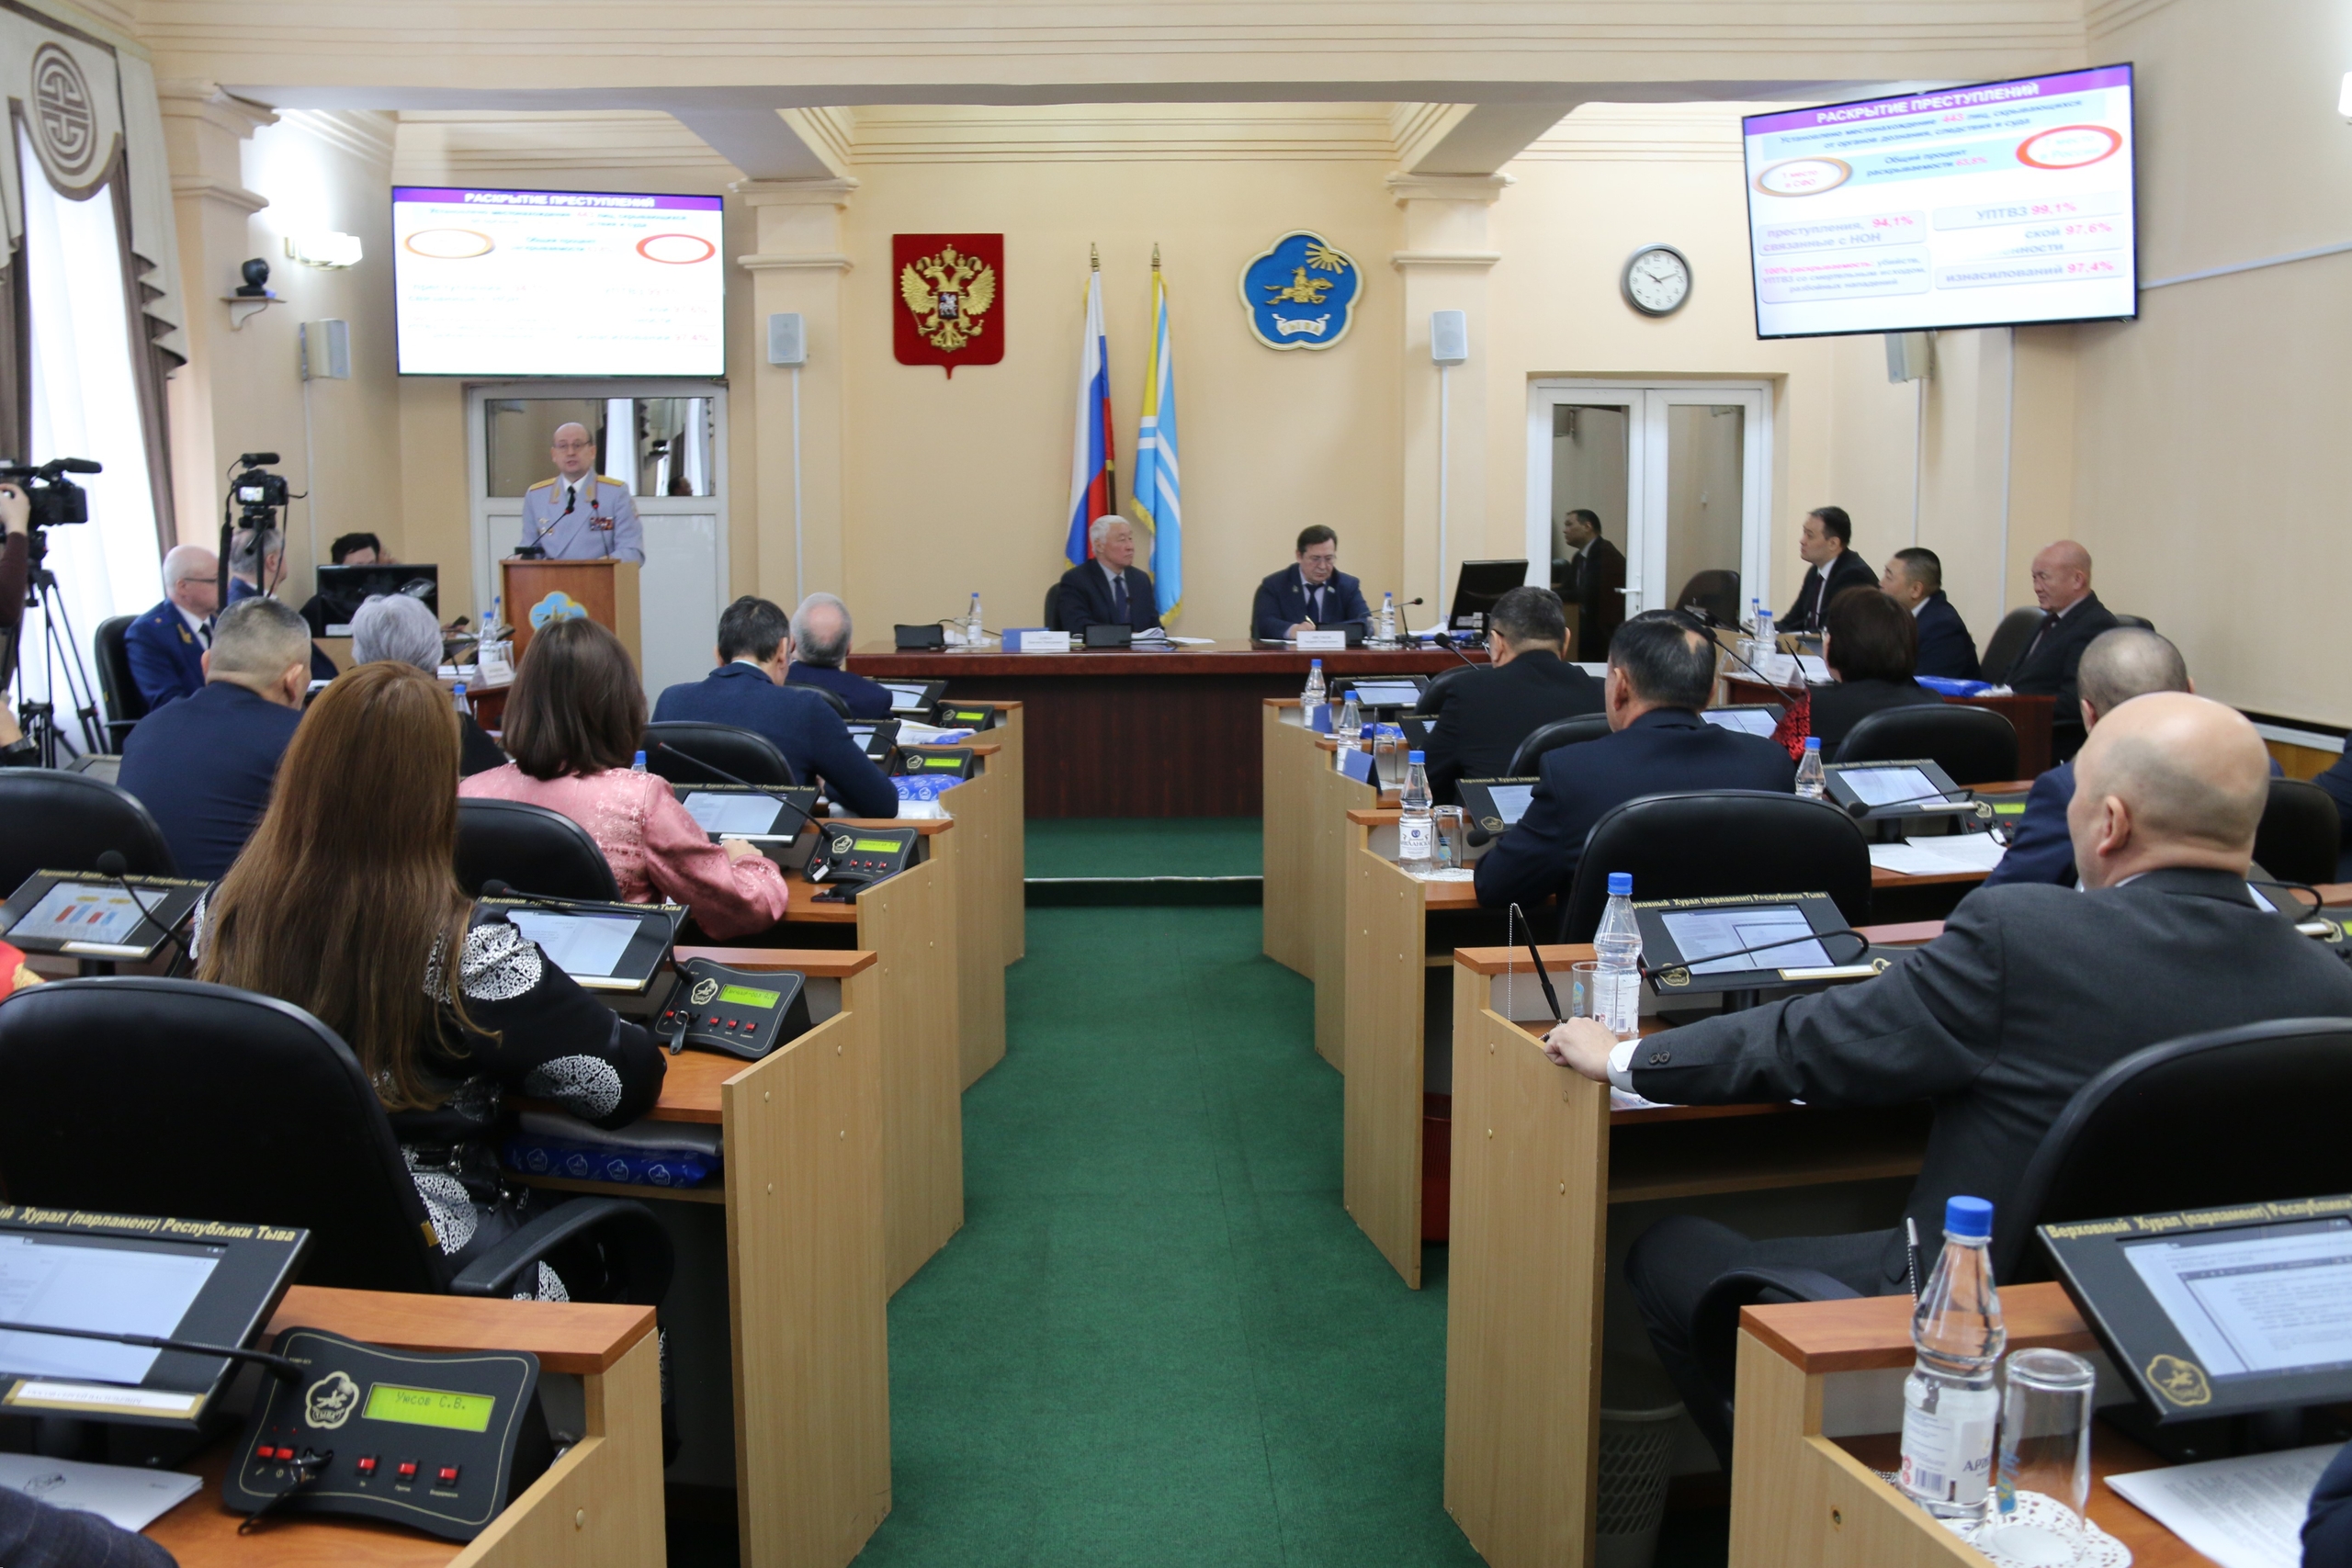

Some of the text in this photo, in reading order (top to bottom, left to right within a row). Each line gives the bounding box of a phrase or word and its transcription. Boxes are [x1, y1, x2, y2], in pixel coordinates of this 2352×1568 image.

[1816, 82, 2039, 123] РАСКРЫТИЕ ПРЕСТУПЛЕНИЙ
[465, 193, 655, 208] РАСКРЫТИЕ ПРЕСТУПЛЕНИЙ
[2031, 202, 2077, 215] 99,1%
[1767, 216, 1914, 238] преступления, 94,1%
[2025, 222, 2112, 239] ской 97,6%
[1763, 238, 1835, 252] связанные
[1850, 232, 1881, 243] НОН
[1946, 261, 2114, 282] изнасилований 97,4%
[661, 903, 682, 911] Тыва
[1673, 897, 1701, 908] Хурал
[1701, 895, 1753, 906] (парламент)
[1803, 891, 1826, 899] Тыва
[18, 1206, 68, 1224] Хурал
[67, 1210, 161, 1233] (парламент)
[162, 1217, 253, 1238] Республики
[256, 1224, 296, 1242] Тыва
[2046, 1198, 2351, 1239] Верховный Хурал (парламент) Республики
[439, 1394, 466, 1410] С.В.
